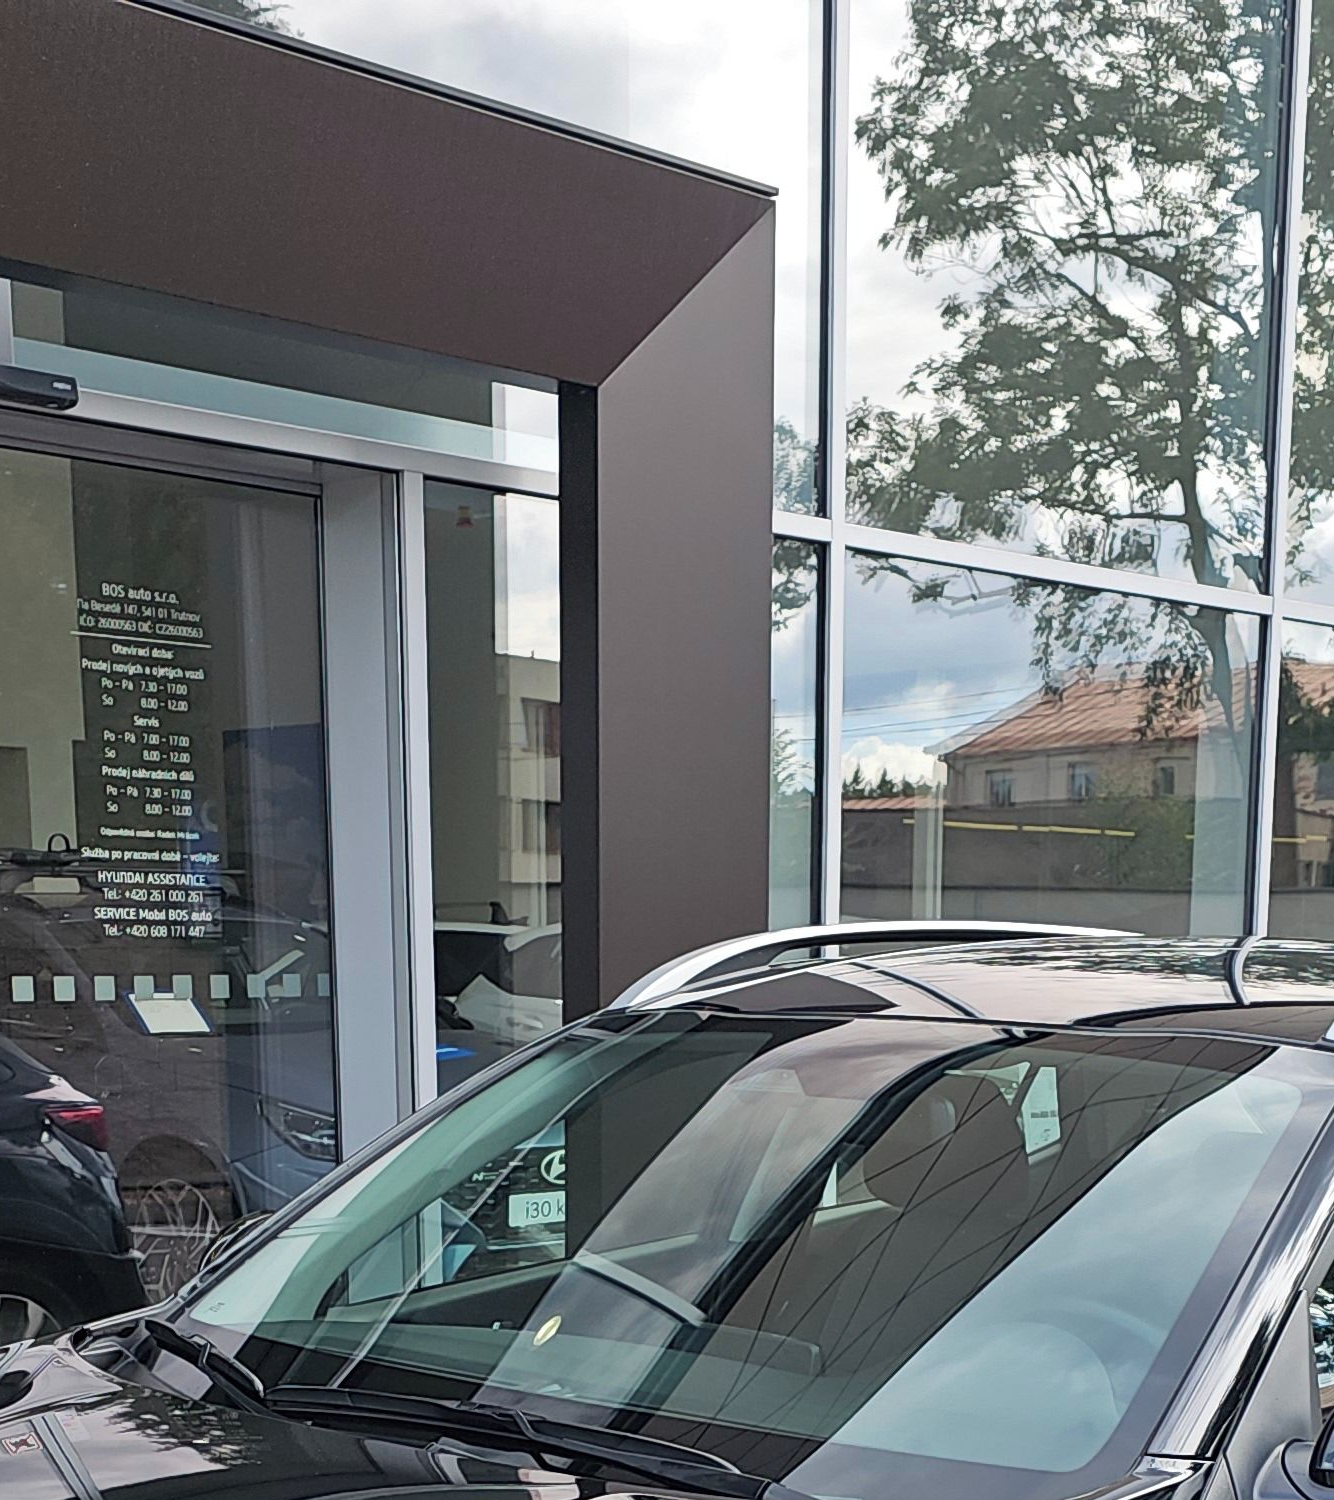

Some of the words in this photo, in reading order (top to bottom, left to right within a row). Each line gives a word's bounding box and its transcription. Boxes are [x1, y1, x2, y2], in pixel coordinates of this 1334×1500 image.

[102, 583, 125, 597] BOS
[128, 588, 151, 601] auto
[154, 592, 179, 605] s.r.o.
[142, 606, 156, 617] 541
[158, 608, 168, 619] 01
[82, 658, 110, 673] Prodej
[102, 678, 113, 688] Po
[102, 694, 114, 706] So
[134, 715, 160, 727] Servis
[104, 731, 116, 741] Po
[105, 747, 116, 758] So
[102, 766, 130, 780] Prodej
[107, 785, 118, 796] Po
[107, 801, 119, 813] So
[81, 847, 109, 859] Služba
[112, 850, 123, 861] po
[98, 871, 145, 884] HYUNDAI
[147, 872, 207, 886] ASSISTANCE
[125, 889, 147, 901] +420
[150, 890, 166, 901] 261
[169, 891, 186, 903] 000
[188, 892, 204, 903] 261
[94, 907, 136, 920] SERVICE
[139, 909, 166, 921] Mobil
[169, 910, 188, 921] BOS
[191, 911, 213, 922] auto
[125, 925, 148, 937] +420
[151, 926, 168, 937] 608
[171, 926, 186, 938] 171
[188, 926, 205, 938] 447
[525, 1201, 552, 1220] i30
